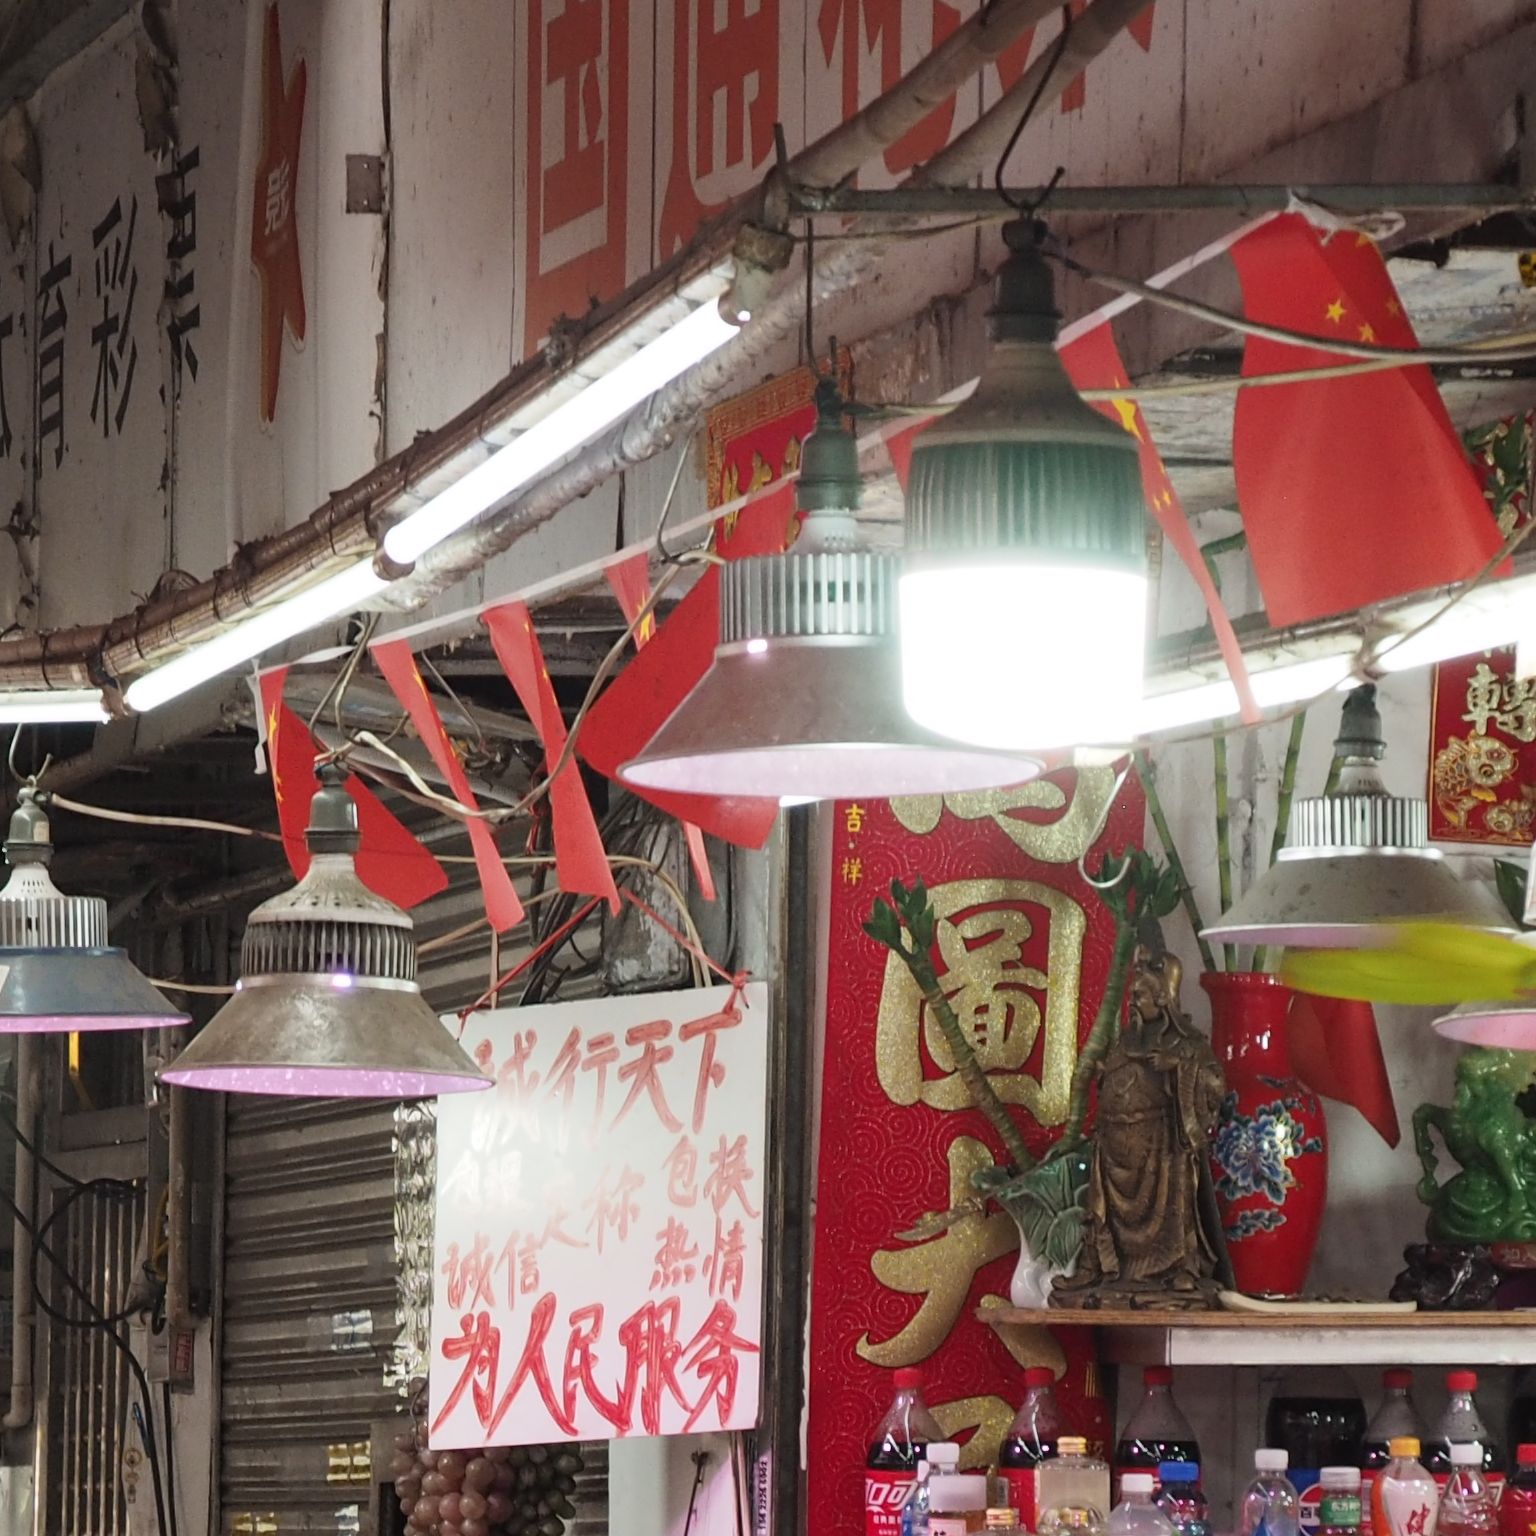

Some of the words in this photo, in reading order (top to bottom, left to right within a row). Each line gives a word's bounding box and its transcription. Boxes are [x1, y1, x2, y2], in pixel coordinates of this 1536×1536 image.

[431, 1290, 760, 1442] 为人民服务
